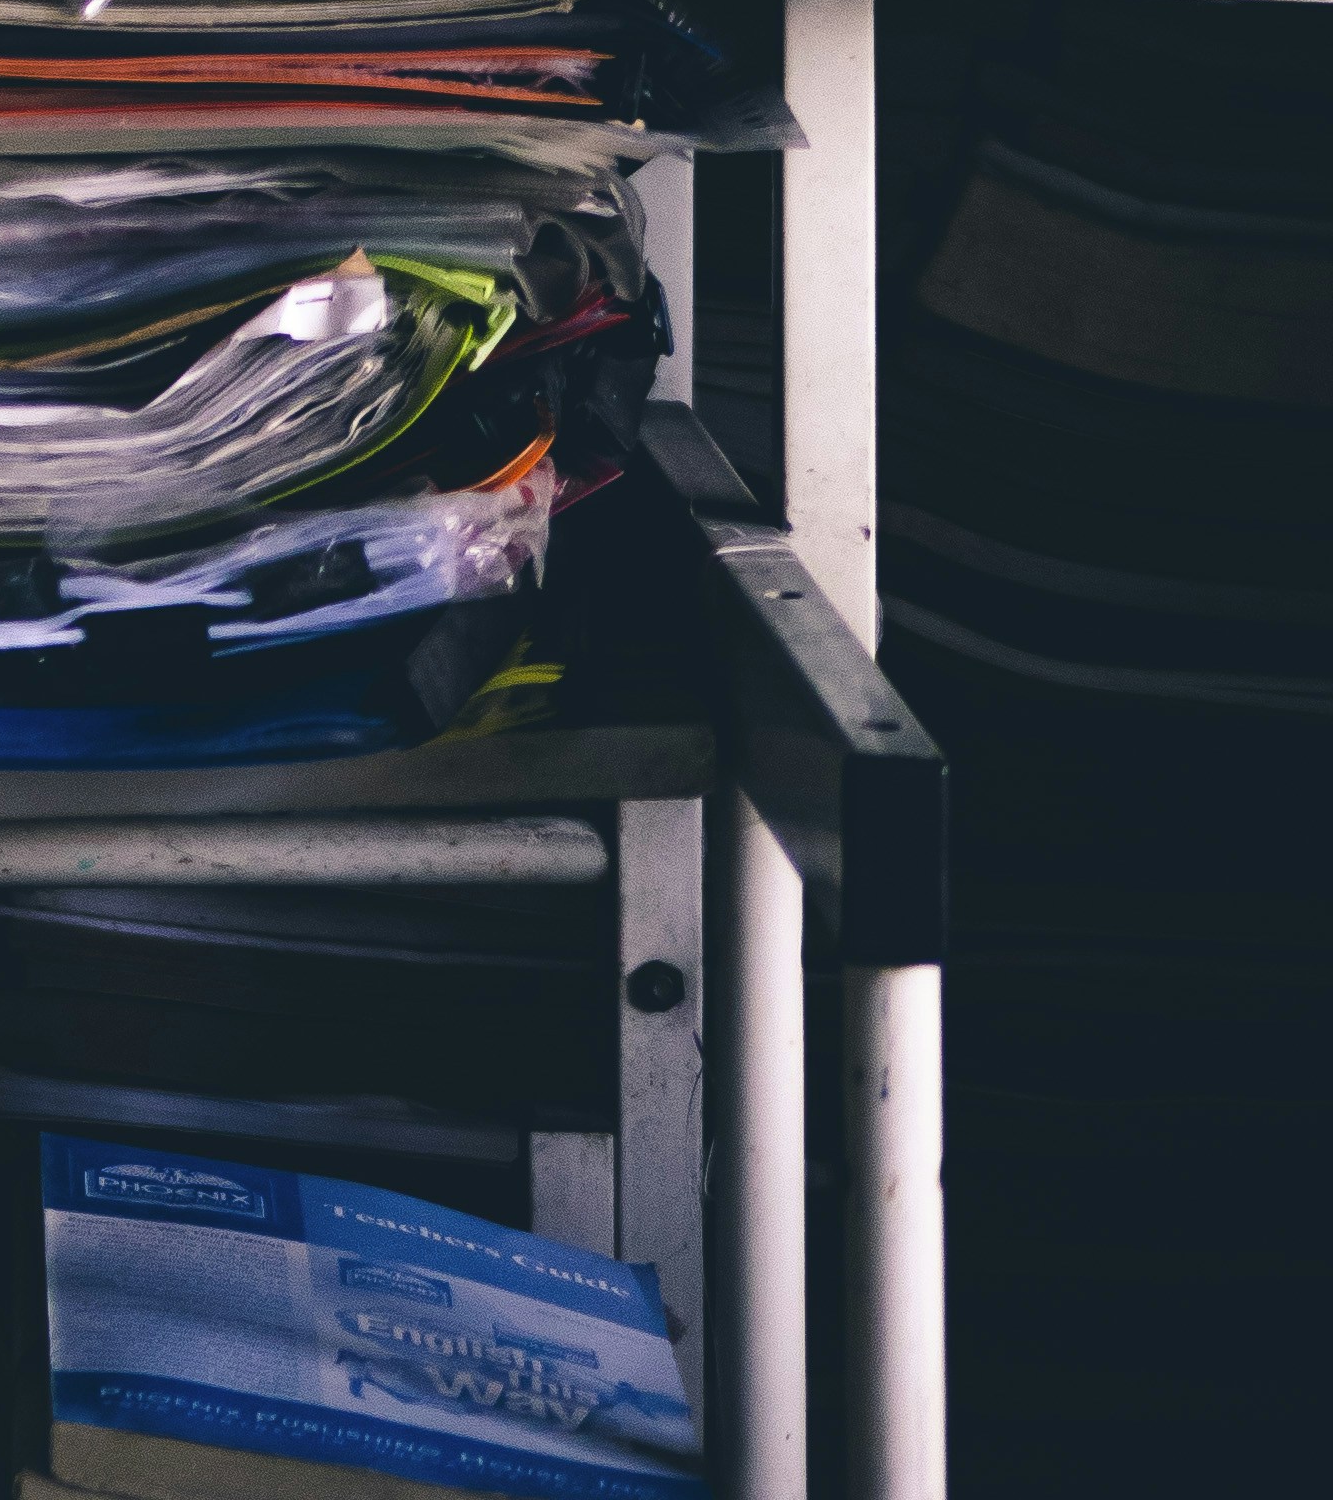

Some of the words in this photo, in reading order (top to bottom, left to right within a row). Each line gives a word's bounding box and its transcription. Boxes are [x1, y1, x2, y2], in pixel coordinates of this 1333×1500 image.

[511, 1252, 632, 1299] Guide
[356, 1312, 545, 1375] English
[424, 1364, 593, 1434] Way
